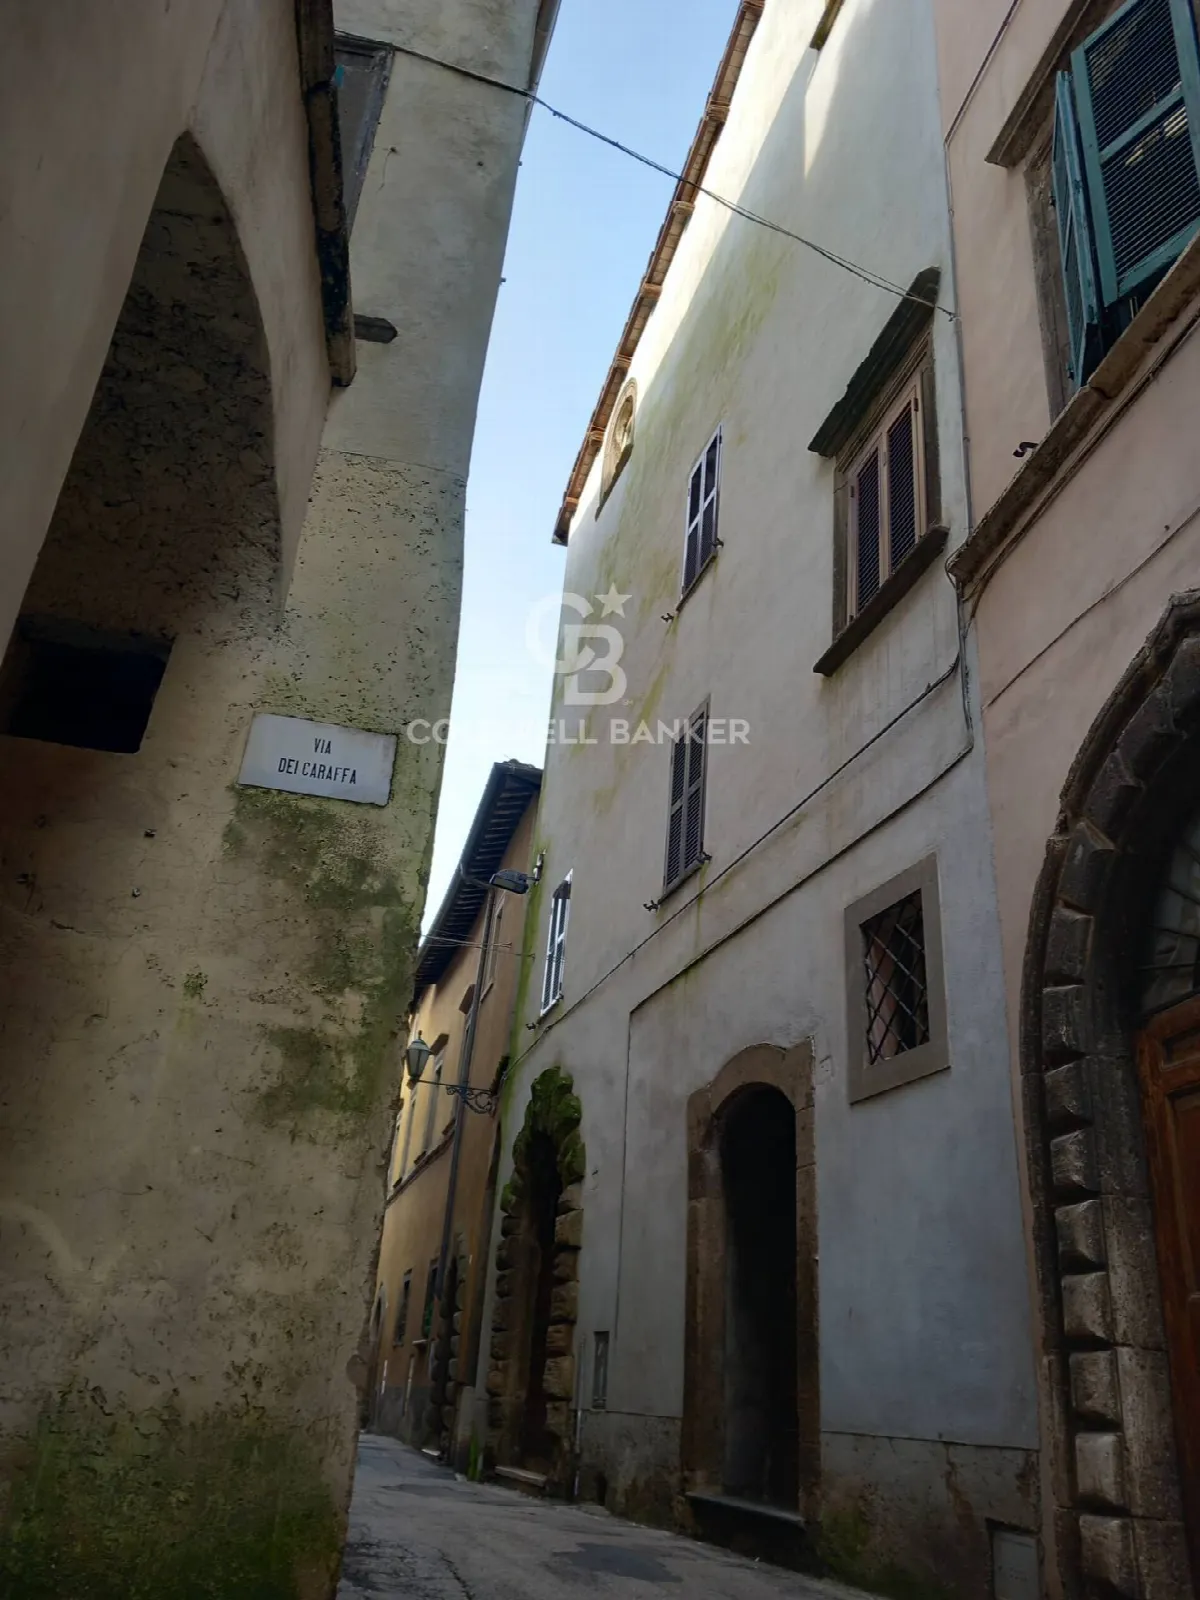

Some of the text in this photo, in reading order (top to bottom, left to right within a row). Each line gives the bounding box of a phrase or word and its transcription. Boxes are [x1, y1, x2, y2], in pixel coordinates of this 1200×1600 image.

[314, 738, 332, 755] VIA
[278, 757, 357, 785] DEI CARAFFA
